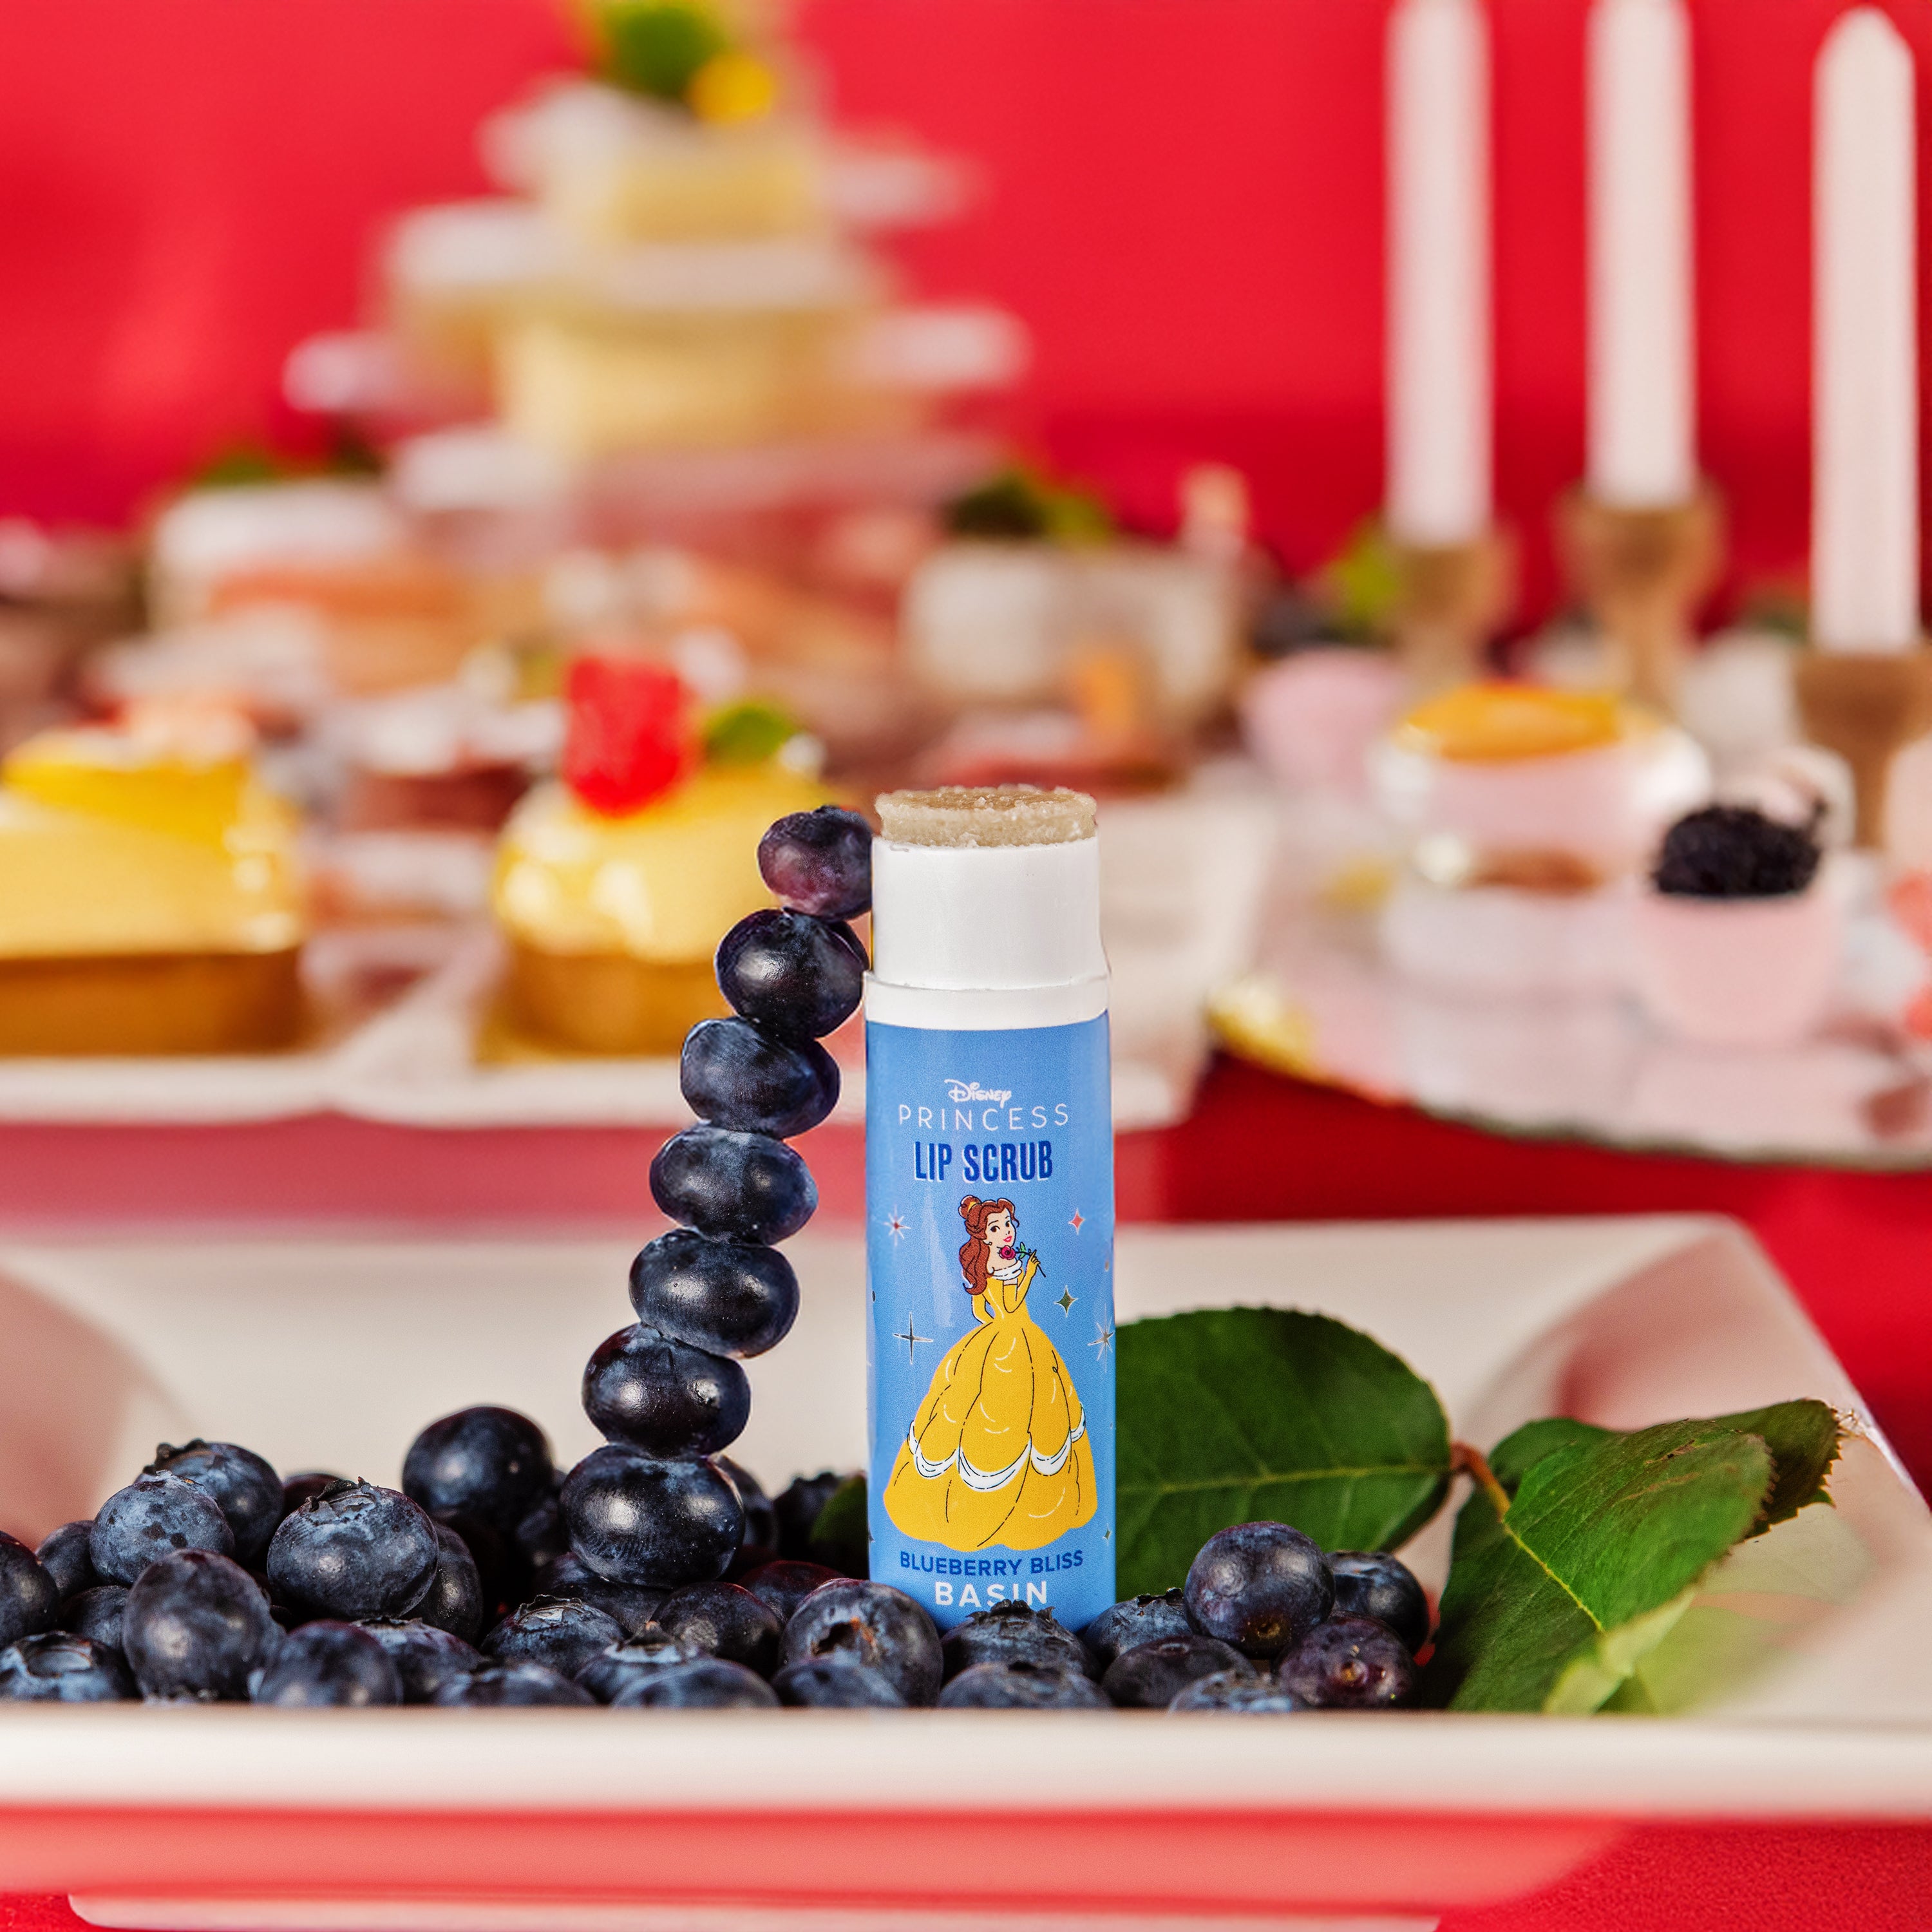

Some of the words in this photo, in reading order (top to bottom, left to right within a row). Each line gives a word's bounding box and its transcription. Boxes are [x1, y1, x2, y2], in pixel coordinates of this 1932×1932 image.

[944, 1079, 1012, 1108] Disney
[899, 1103, 1068, 1131] PRINCESS
[914, 1141, 952, 1182] LIP
[962, 1141, 1053, 1184] SCRUB
[900, 1551, 1022, 1576] BLUEBERRY
[1030, 1549, 1083, 1573] BLISS
[934, 1580, 1047, 1607] BASIN
